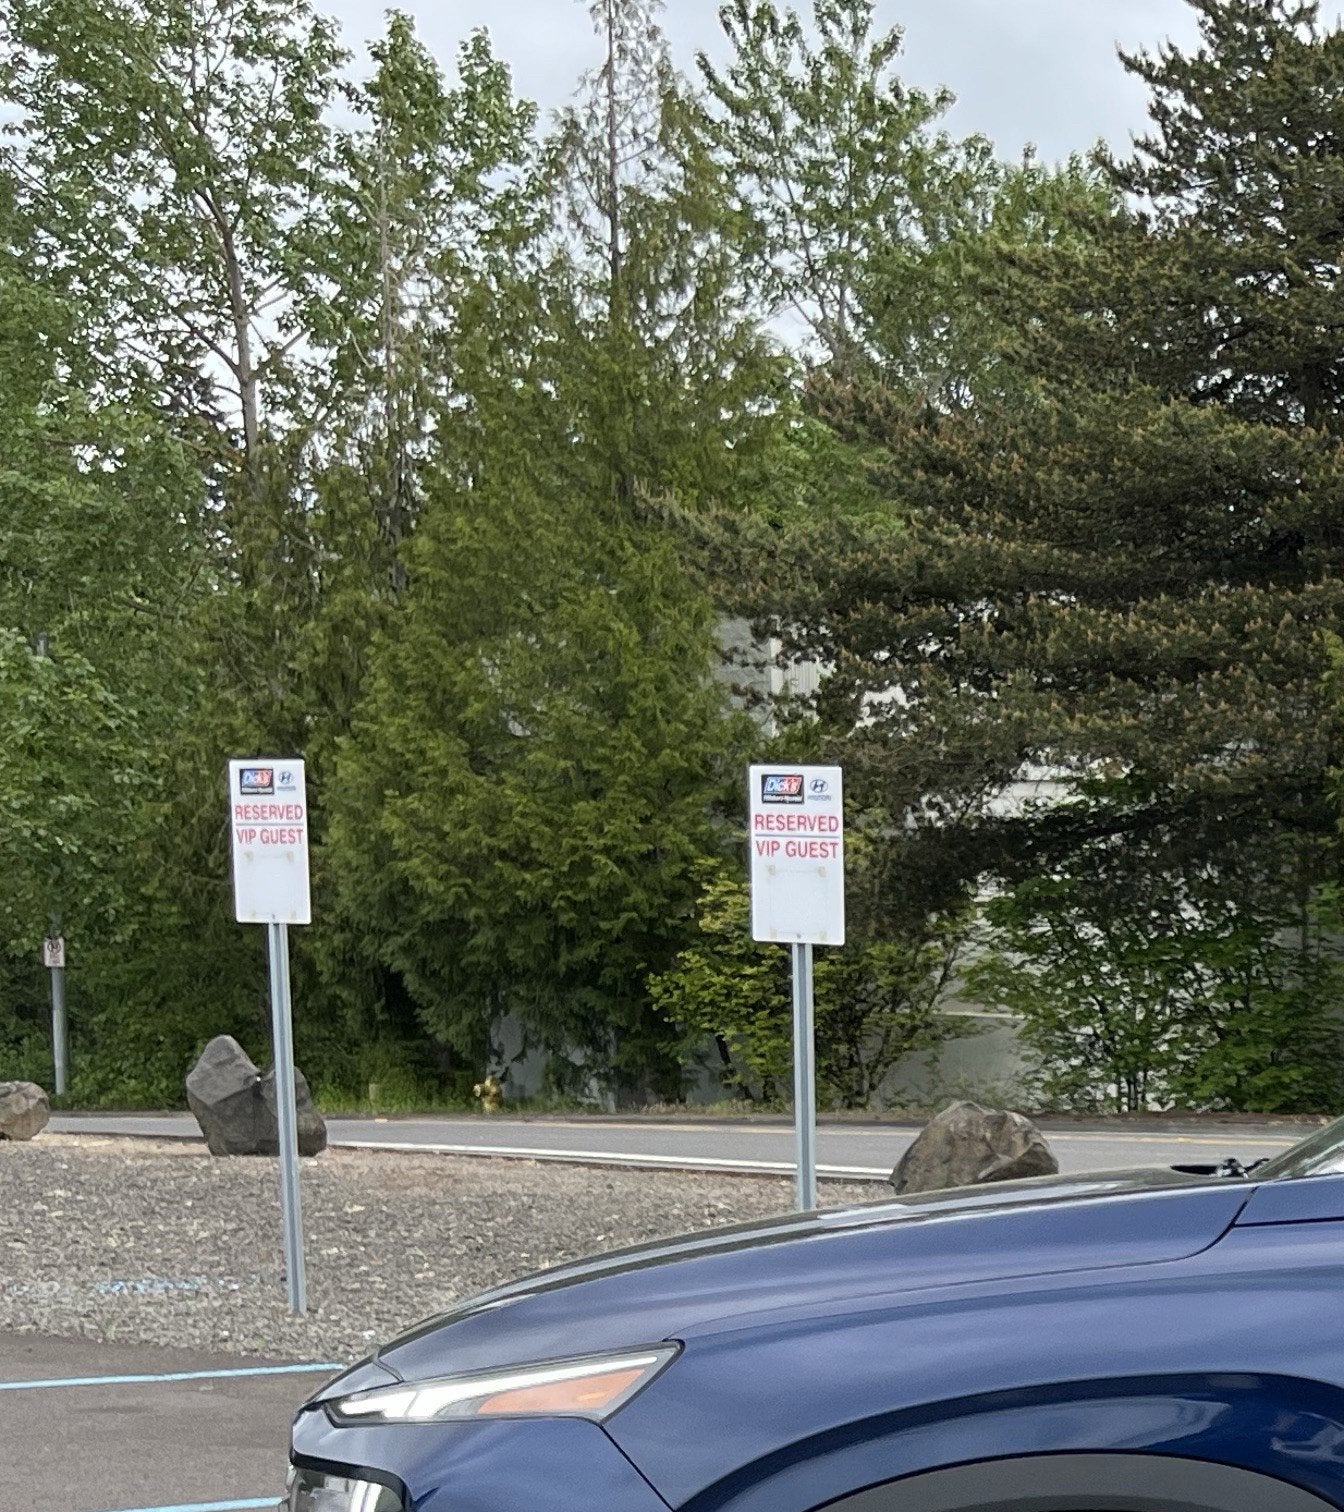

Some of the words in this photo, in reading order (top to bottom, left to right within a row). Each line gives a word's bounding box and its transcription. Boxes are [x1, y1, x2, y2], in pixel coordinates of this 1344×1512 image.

[234, 804, 304, 821] RESERVED
[754, 814, 839, 833] RESERVED
[236, 828, 257, 844] VIP
[260, 828, 304, 845] GUEST
[756, 840, 780, 857] VIP
[785, 841, 839, 859] GUEST
